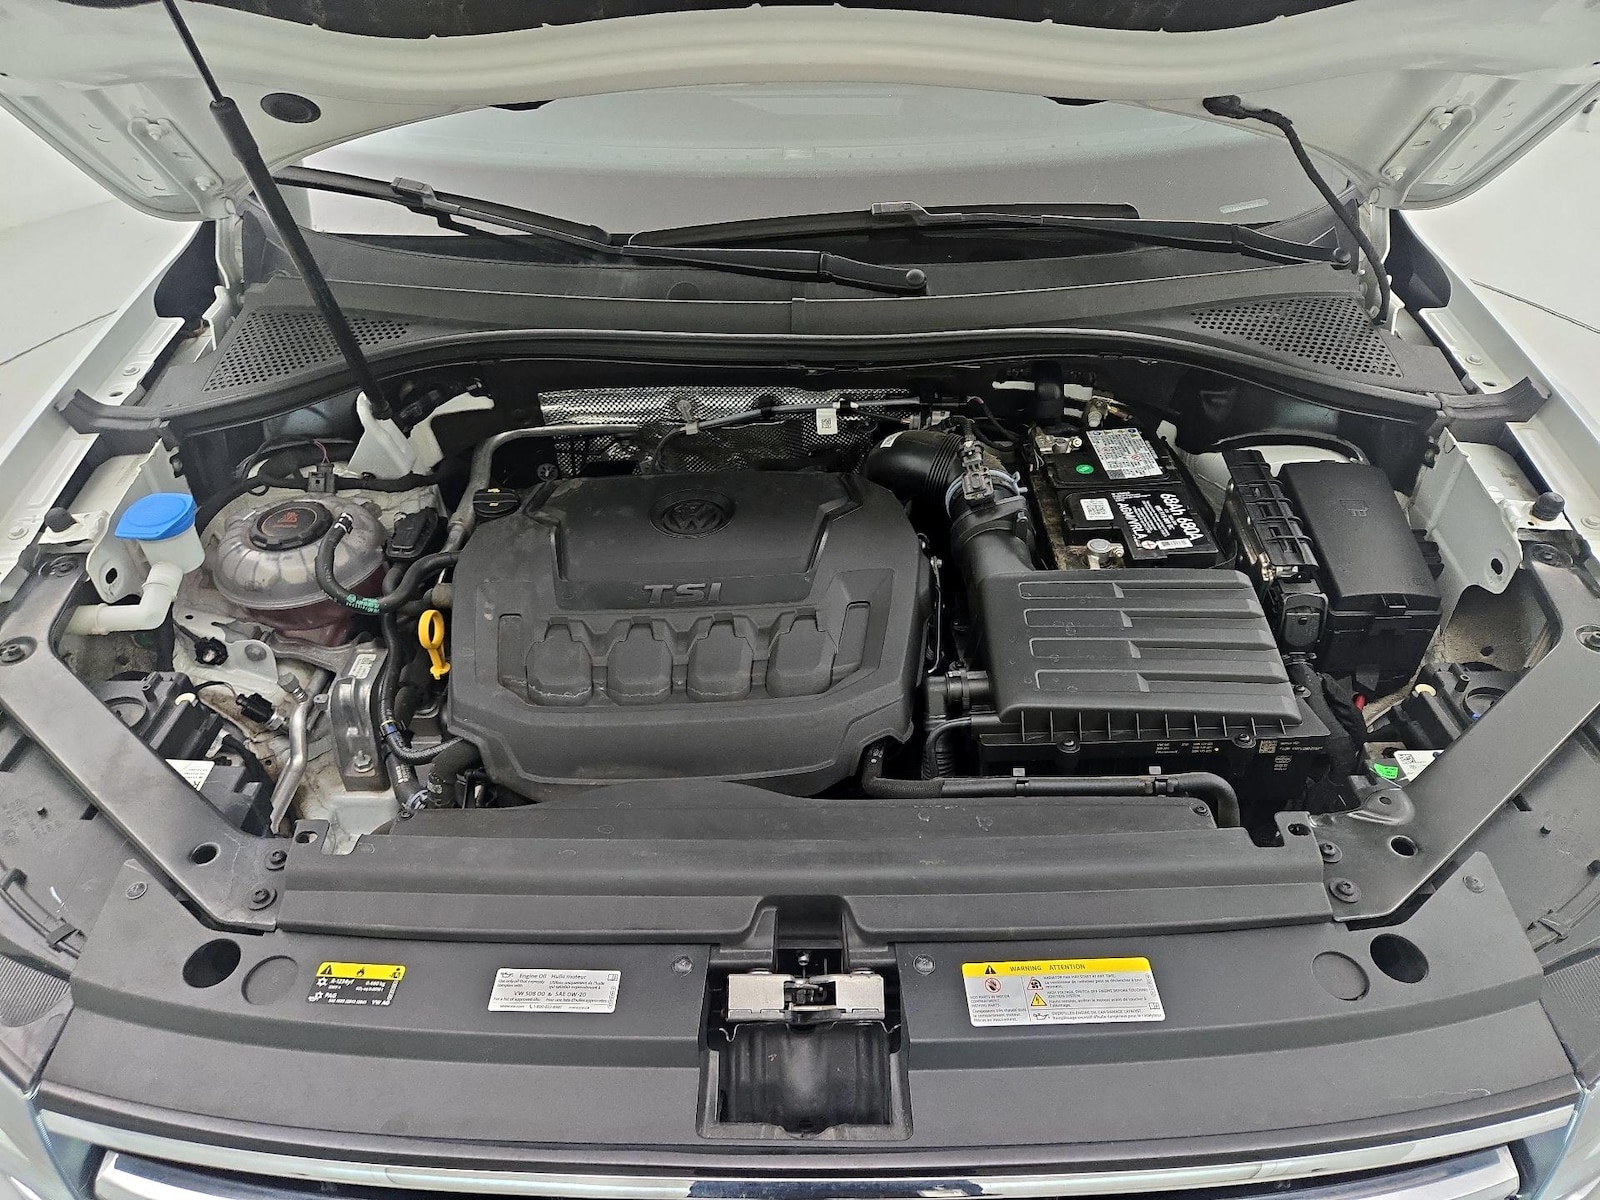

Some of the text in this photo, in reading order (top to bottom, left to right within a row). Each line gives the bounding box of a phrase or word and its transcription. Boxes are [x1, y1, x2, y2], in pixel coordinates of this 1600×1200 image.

[1160, 494, 1186, 516] 68Ah
[1176, 517, 1204, 540] 680A
[643, 582, 722, 603] TSI
[325, 991, 337, 999] PAG
